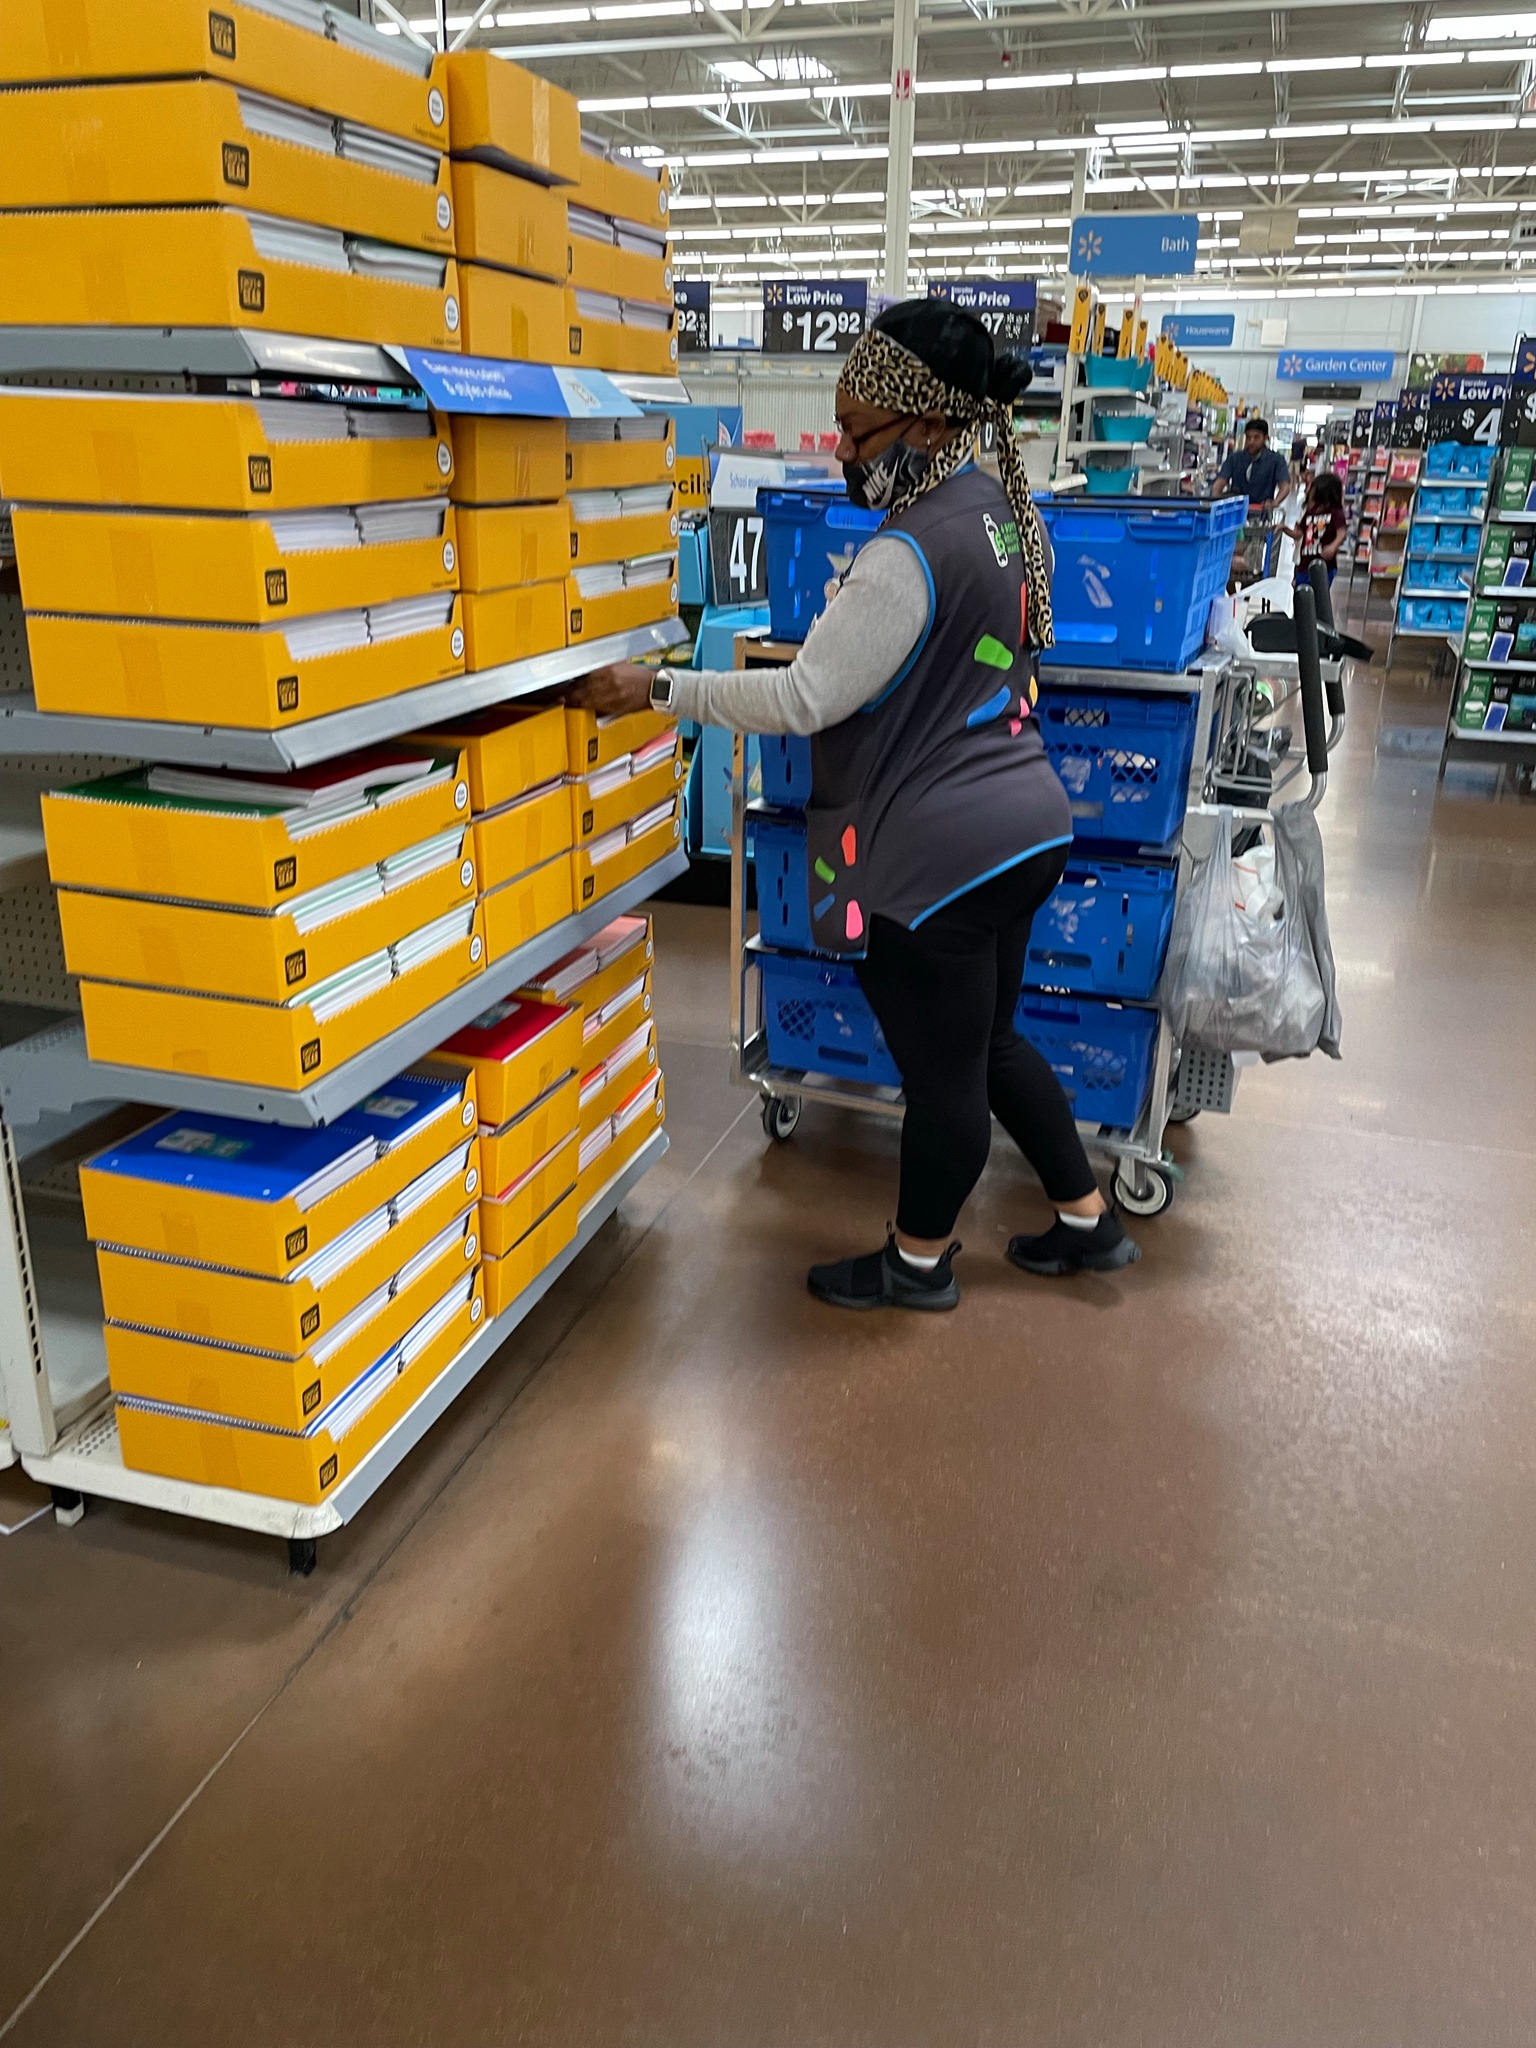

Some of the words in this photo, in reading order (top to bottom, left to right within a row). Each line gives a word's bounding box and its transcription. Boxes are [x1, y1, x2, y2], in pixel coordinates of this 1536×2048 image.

[1161, 236, 1190, 253] Bath
[786, 289, 812, 305] Low
[813, 289, 844, 306] Price
[978, 290, 1011, 307] Price
[1185, 325, 1230, 336] Housewares
[1305, 357, 1347, 372] Garden
[1349, 358, 1388, 373] Center
[1459, 379, 1491, 400] Low
[729, 516, 764, 594] 47
